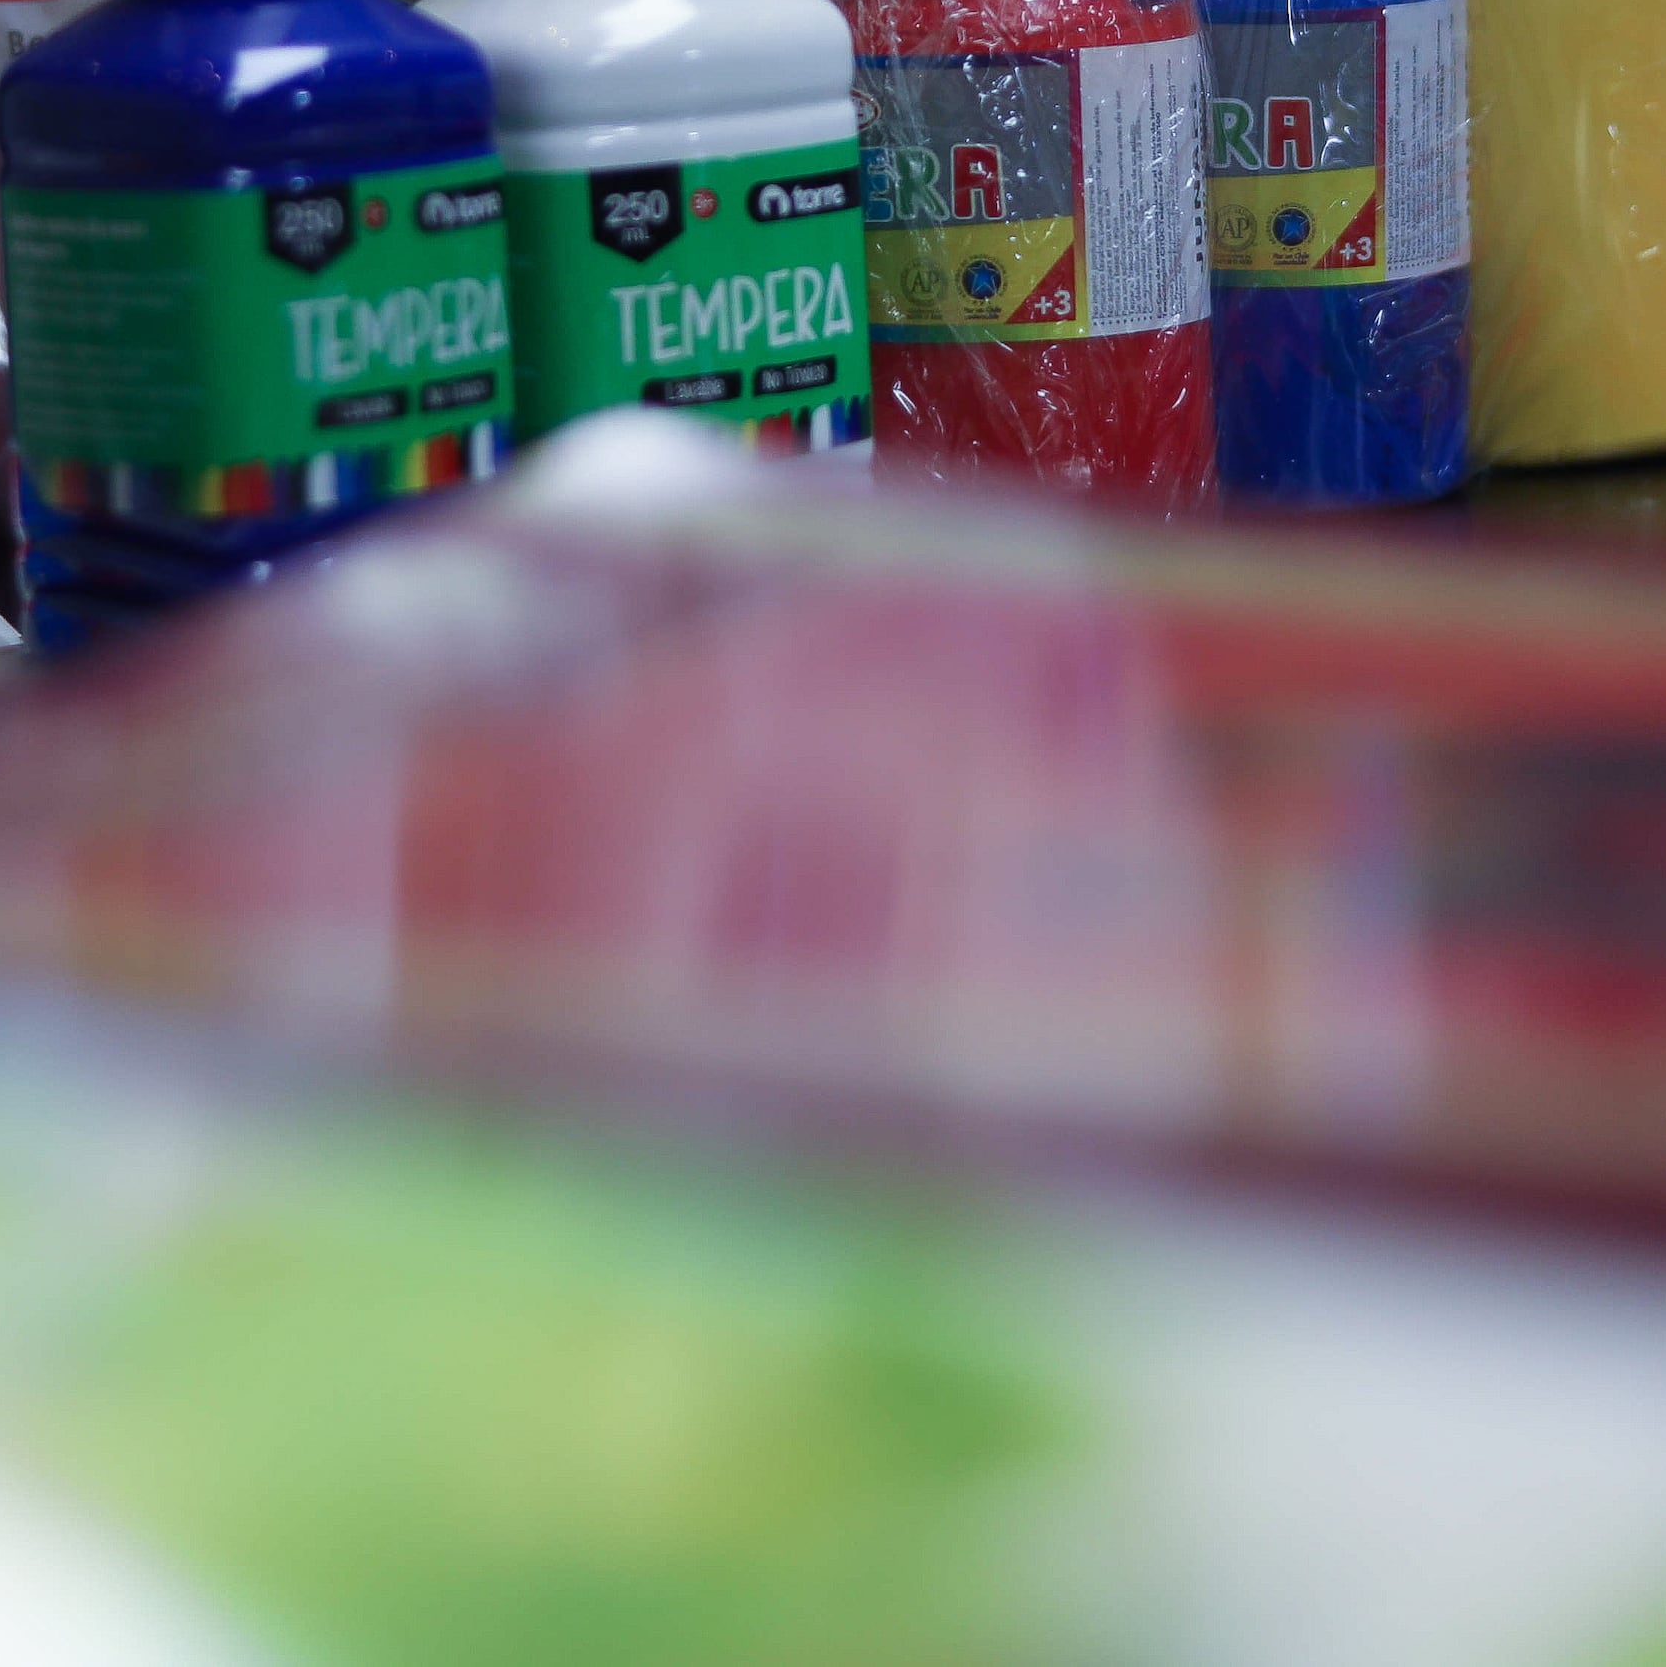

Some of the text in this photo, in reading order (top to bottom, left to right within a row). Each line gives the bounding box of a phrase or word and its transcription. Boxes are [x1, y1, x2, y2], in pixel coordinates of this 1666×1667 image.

[603, 188, 669, 225] 250
[1338, 236, 1373, 261] +3
[609, 263, 854, 366] TÉMPERA
[1034, 289, 1071, 316] +3
